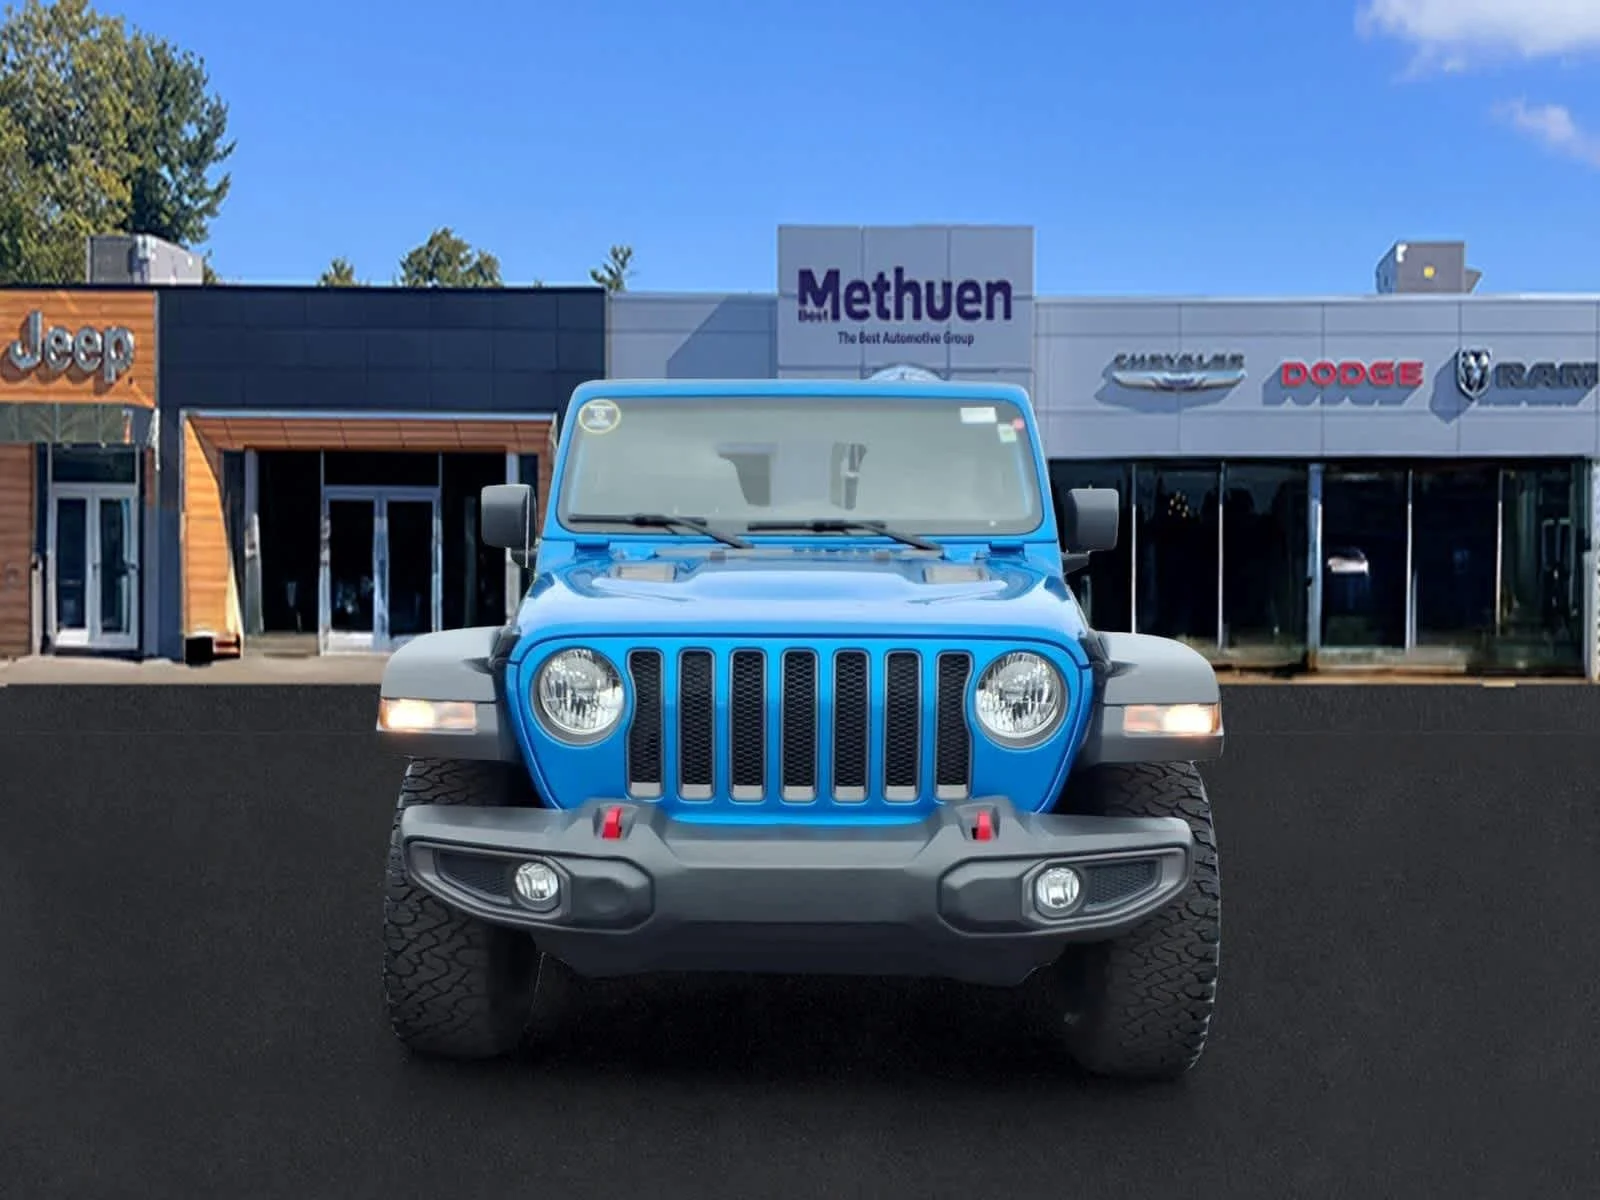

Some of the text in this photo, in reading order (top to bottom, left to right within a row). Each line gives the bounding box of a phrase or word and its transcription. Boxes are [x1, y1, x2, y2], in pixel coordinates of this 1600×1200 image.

[798, 266, 1013, 322] Methuen
[9, 310, 135, 384] Jeep
[838, 331, 975, 347] The Best Automotive Group
[1114, 353, 1245, 369] CHRYSLER
[1281, 361, 1424, 387] DODGE
[1495, 361, 1599, 389] RAM
